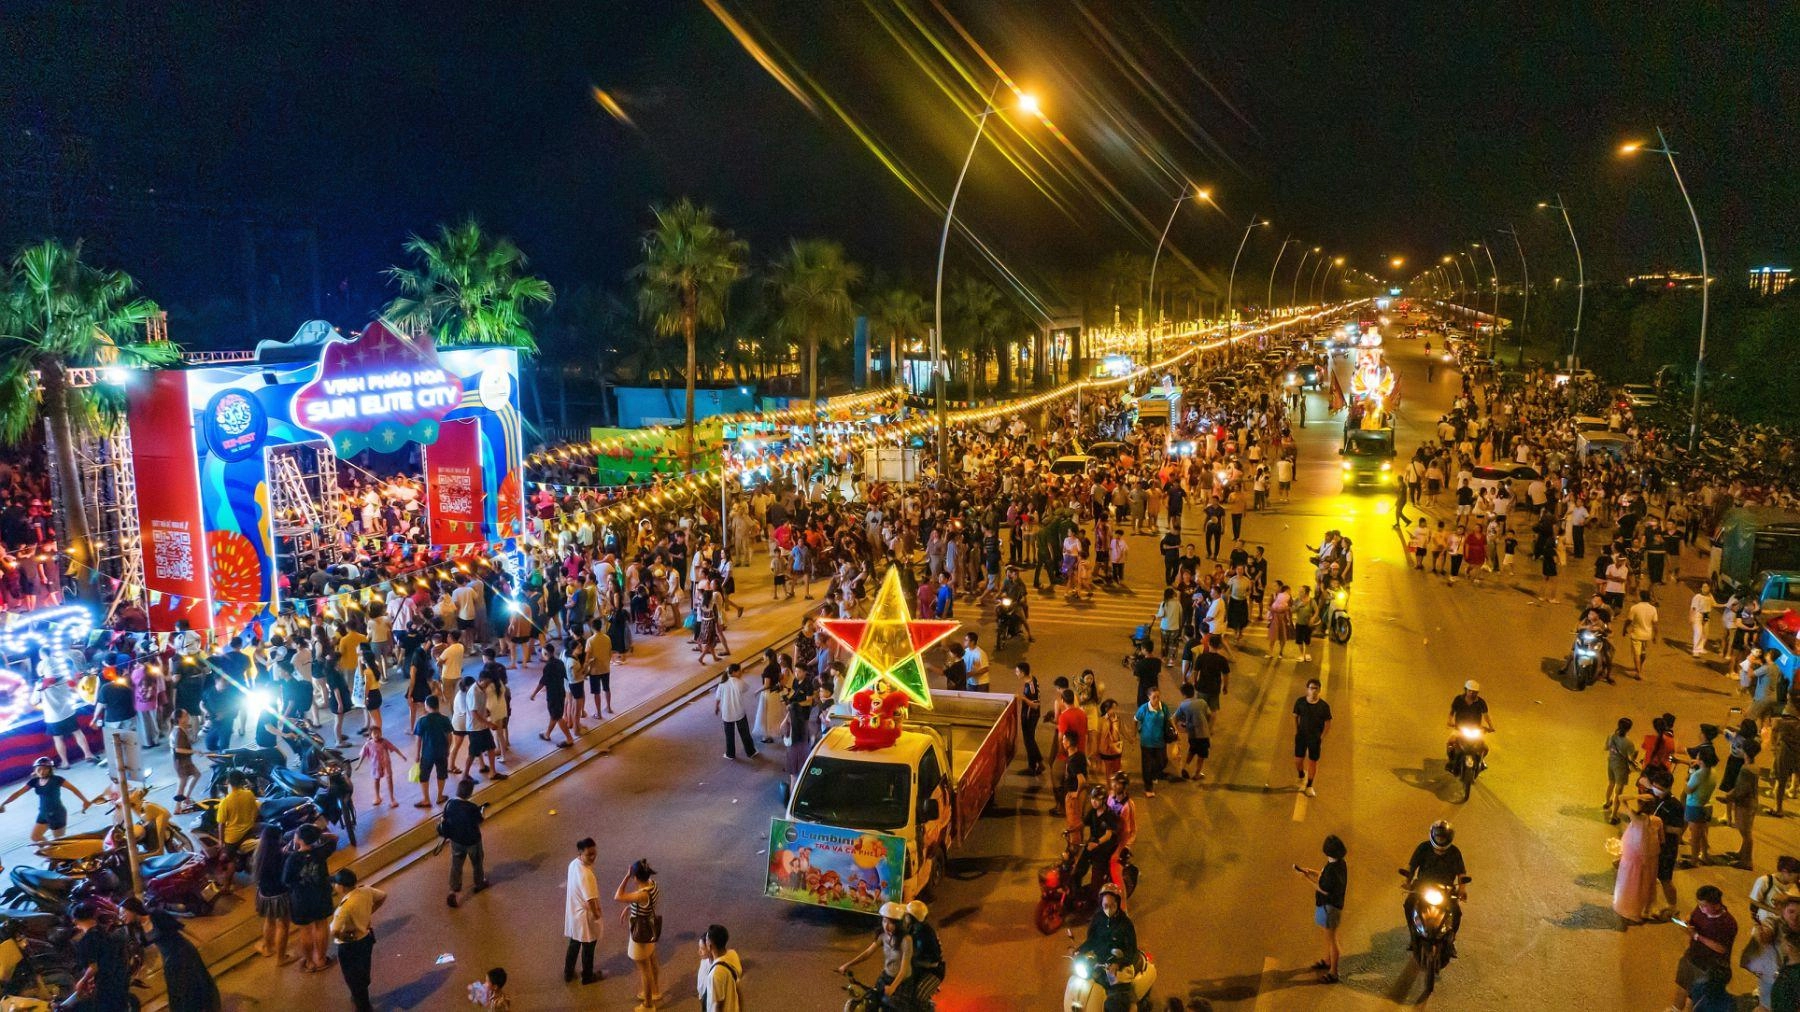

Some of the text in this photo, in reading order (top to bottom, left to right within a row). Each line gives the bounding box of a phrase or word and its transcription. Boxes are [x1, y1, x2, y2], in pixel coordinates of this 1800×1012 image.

[323, 369, 447, 396] VỊNH PHÁO HOA
[306, 386, 458, 422] SUN ELITE CITY
[802, 830, 854, 846] Lumbini
